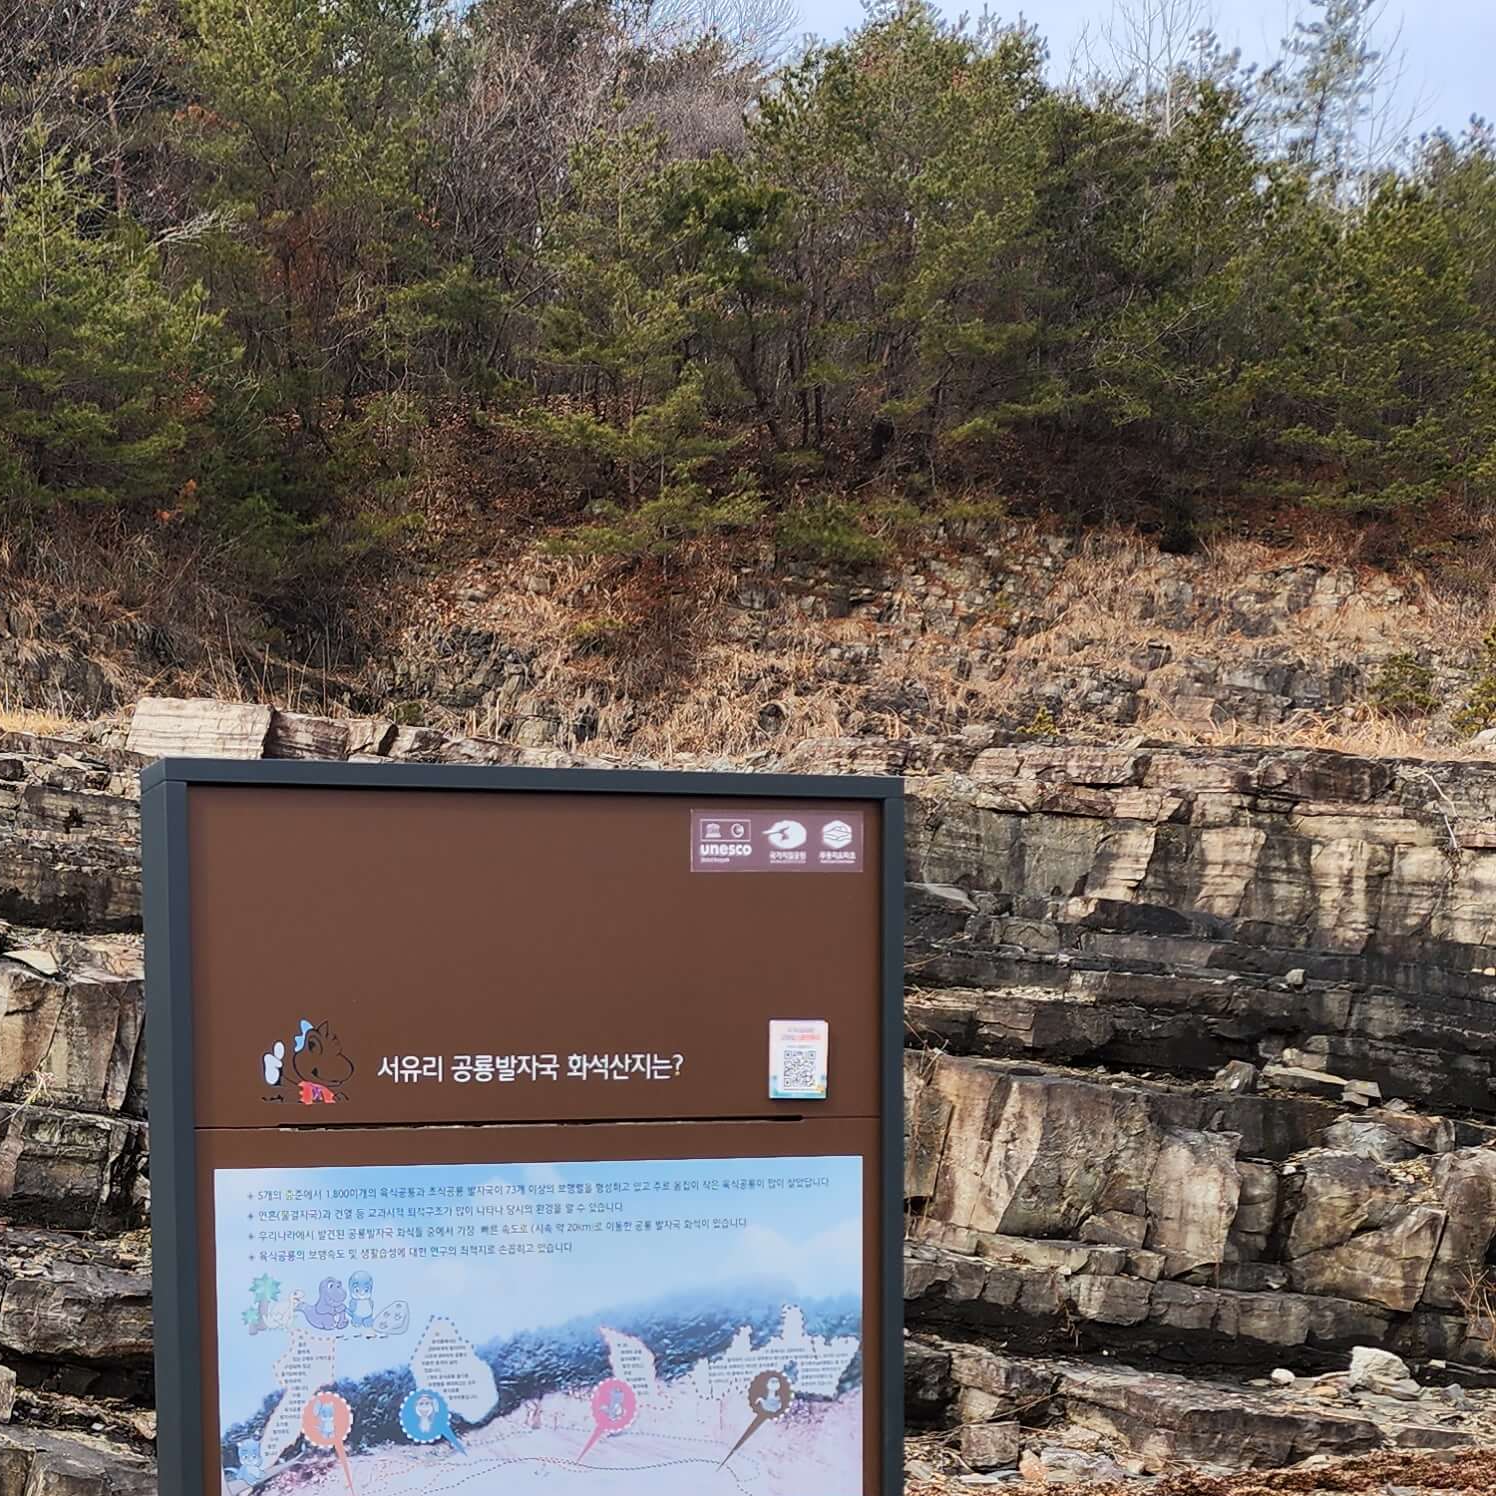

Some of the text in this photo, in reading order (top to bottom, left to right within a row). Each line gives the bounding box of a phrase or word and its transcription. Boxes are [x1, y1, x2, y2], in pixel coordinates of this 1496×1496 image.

[699, 843, 752, 856] unesco
[377, 1053, 683, 1082] 서유리 공룡발자국 화석산지는?
